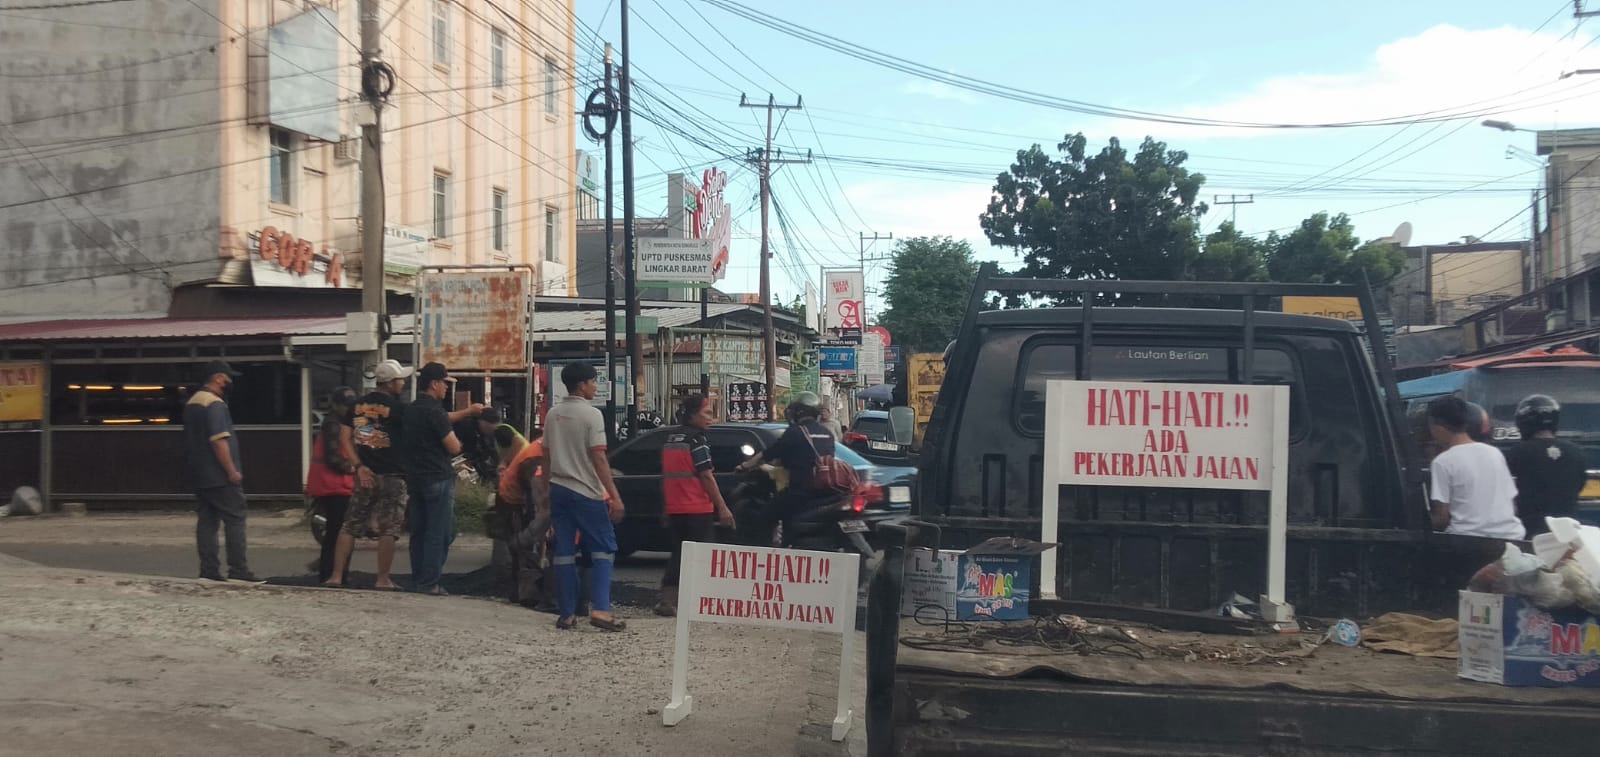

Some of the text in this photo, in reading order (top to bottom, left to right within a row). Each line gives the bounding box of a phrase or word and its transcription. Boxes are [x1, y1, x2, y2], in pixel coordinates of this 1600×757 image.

[641, 253, 712, 262] UPTD PUSKESMAS
[645, 265, 707, 273] LINGKAR BARAT
[1128, 349, 1209, 360] Lautan Berlian
[1143, 429, 1190, 453] ADA
[1074, 451, 1260, 481] PEKERJAAN JALAN
[751, 582, 784, 602] ADA
[978, 573, 1014, 598] MAS
[699, 596, 835, 624] PEKERJAAN JALAN
